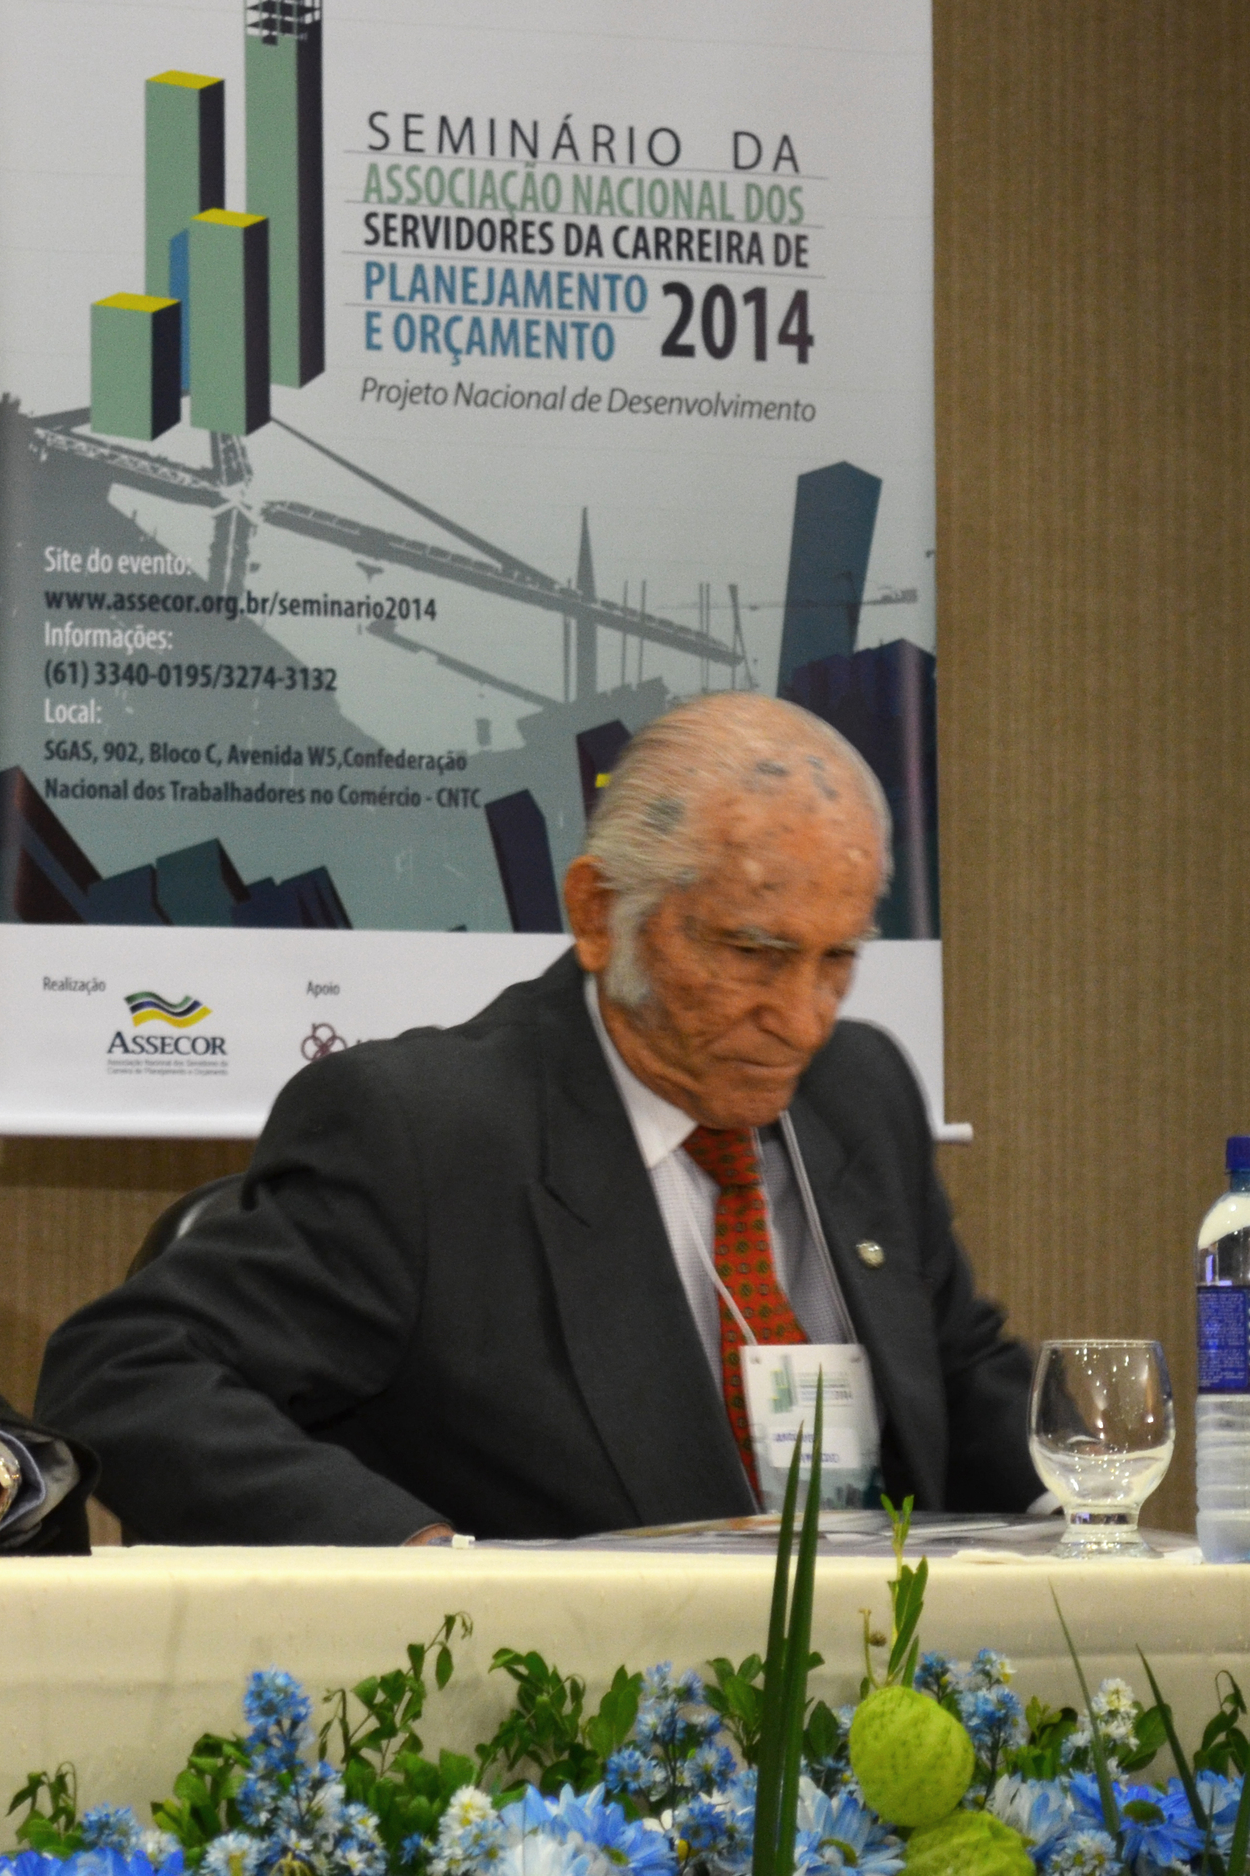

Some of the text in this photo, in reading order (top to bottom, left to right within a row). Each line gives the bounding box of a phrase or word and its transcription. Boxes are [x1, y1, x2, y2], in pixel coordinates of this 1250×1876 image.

[367, 111, 799, 173] SEMINÁRIO DA
[363, 161, 805, 226] ASSOCIAÇÃO NACIONAL DOS
[363, 211, 809, 268] SERVIDORES DA CARREIRA DE
[365, 261, 648, 314] PLANEJAMENTO
[365, 311, 615, 366] E ORÇAMENTO
[661, 281, 815, 365] 2014
[360, 376, 817, 423] Projeto Nacional de Desenvolvimento
[44, 546, 192, 576] Site do evento:
[44, 589, 437, 621] www.assecor.org.br/seminario2014
[44, 620, 174, 655] Informações:
[44, 659, 338, 692] (61) 3340-0195/3274-3132
[44, 698, 102, 724] Local:
[44, 740, 98, 765] SGAS,
[102, 741, 144, 766] 902,
[149, 742, 201, 765] Bloco
[205, 743, 222, 768] C,
[227, 744, 303, 768] Avenida
[44, 778, 129, 801] Nacional
[133, 779, 166, 802] dos
[170, 781, 305, 805] Trabalhadores
[310, 789, 334, 806] no
[339, 785, 422, 808] Comércio
[436, 787, 483, 810] CNTC
[42, 976, 107, 996] Realização
[306, 980, 341, 998] Apoio
[107, 1031, 228, 1056] ASSECOR
